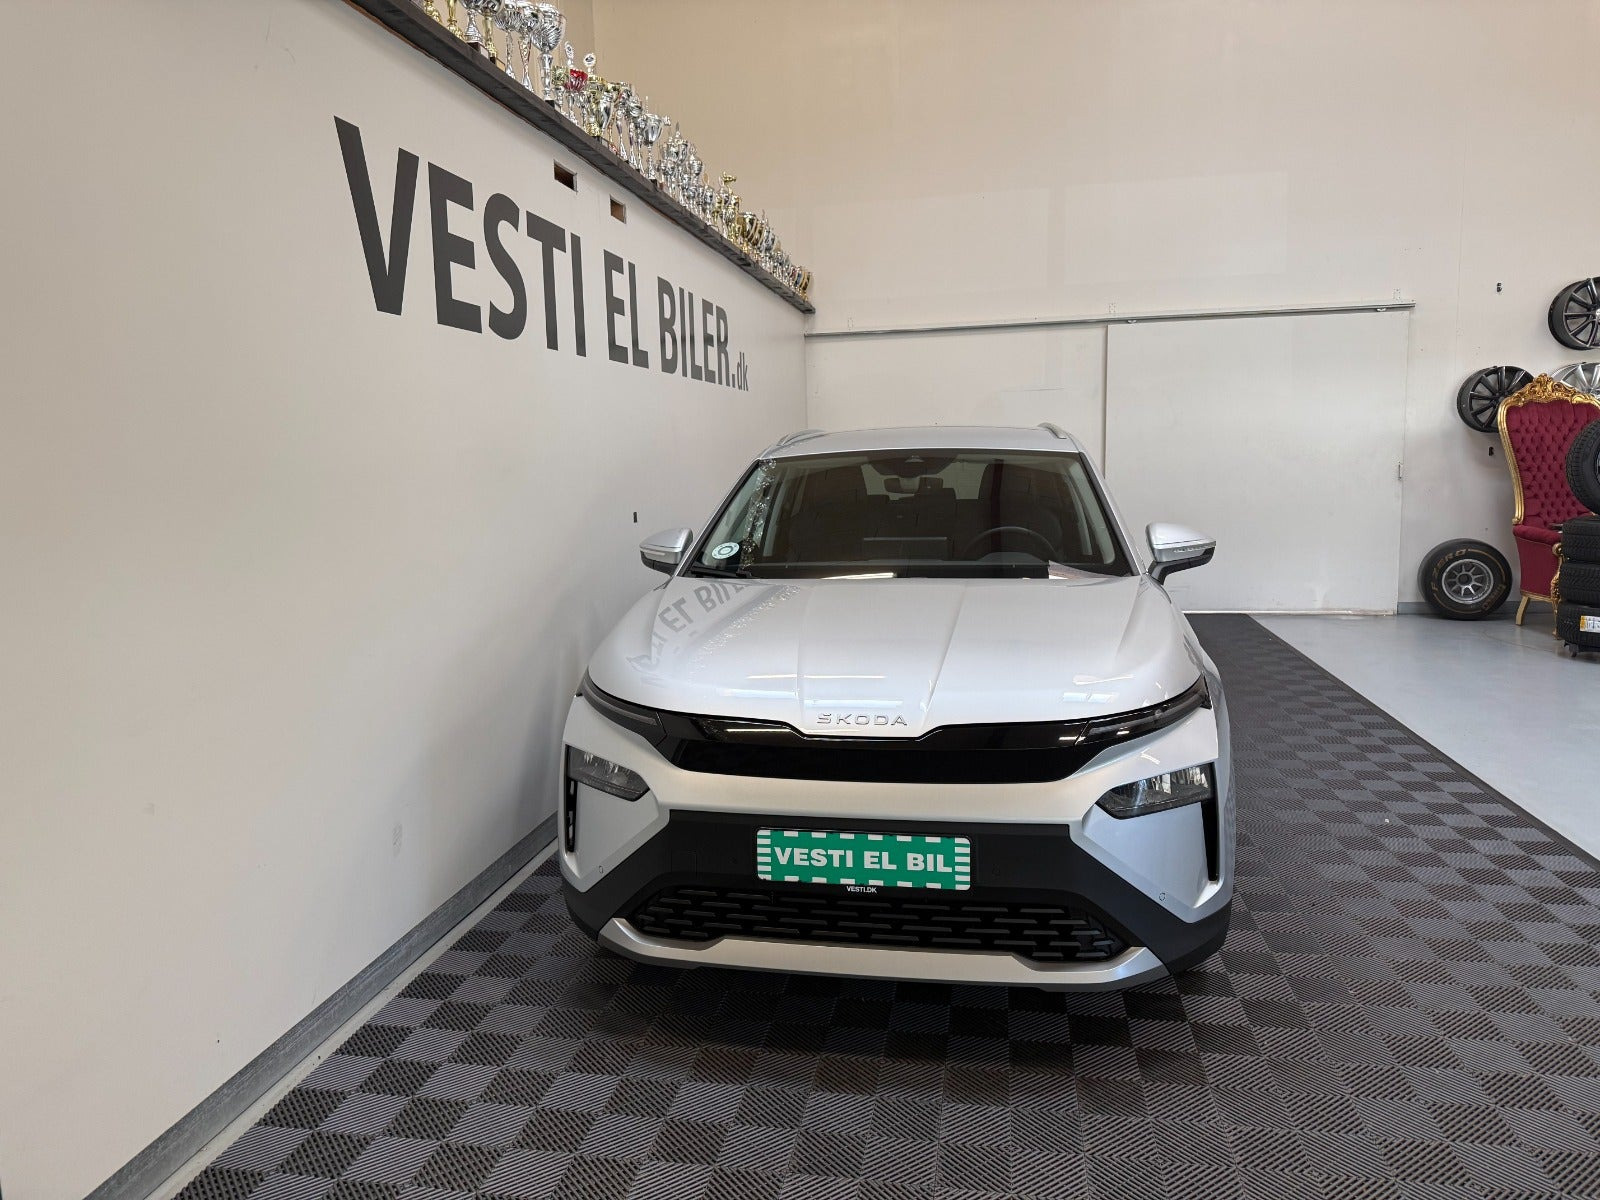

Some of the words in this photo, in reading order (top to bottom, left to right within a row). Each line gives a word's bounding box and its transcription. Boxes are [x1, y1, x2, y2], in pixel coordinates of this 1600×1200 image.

[334, 115, 587, 357] VESTI
[604, 248, 649, 369] EL
[774, 847, 853, 868] VESTI
[863, 852, 897, 871] EL
[907, 853, 953, 873] BIL
